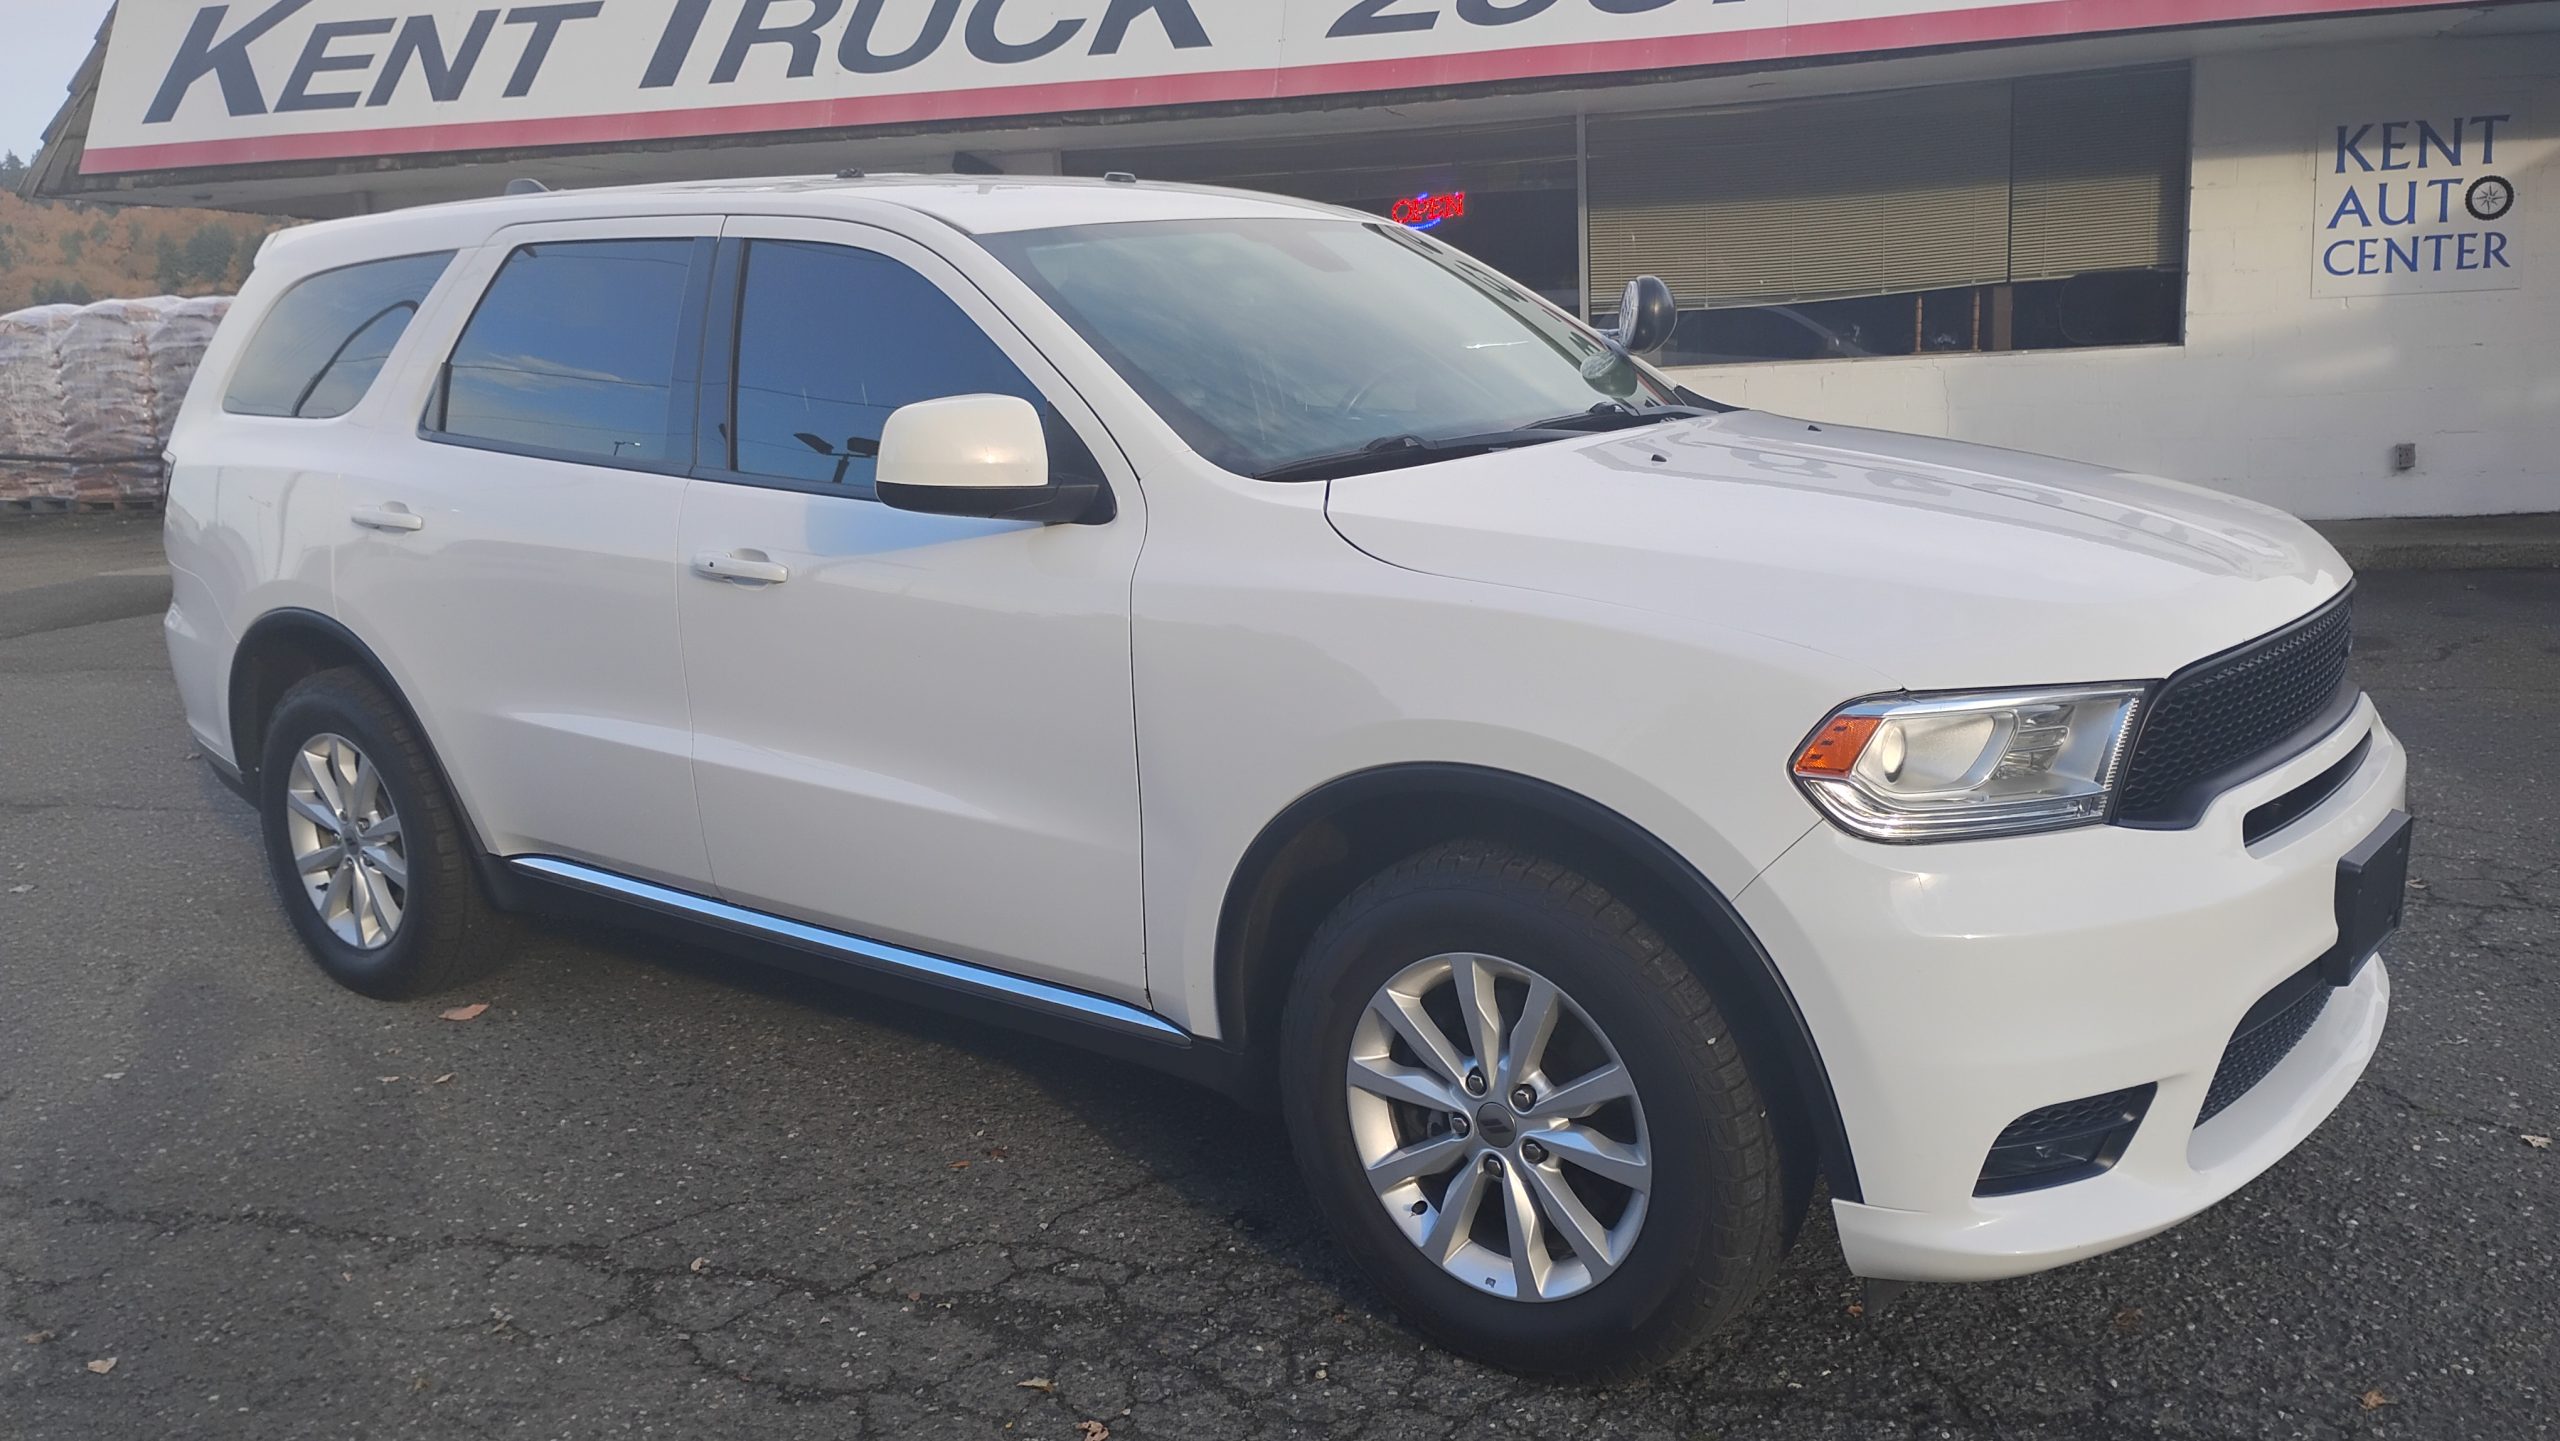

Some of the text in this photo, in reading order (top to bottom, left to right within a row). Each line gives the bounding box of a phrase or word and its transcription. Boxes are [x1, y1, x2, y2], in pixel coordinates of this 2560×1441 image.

[142, 0, 603, 124] KENT
[2335, 114, 2511, 174] KENT
[1391, 192, 1465, 225] OPEN
[2326, 175, 2514, 229] AUTO
[2323, 231, 2511, 276] CENTER
